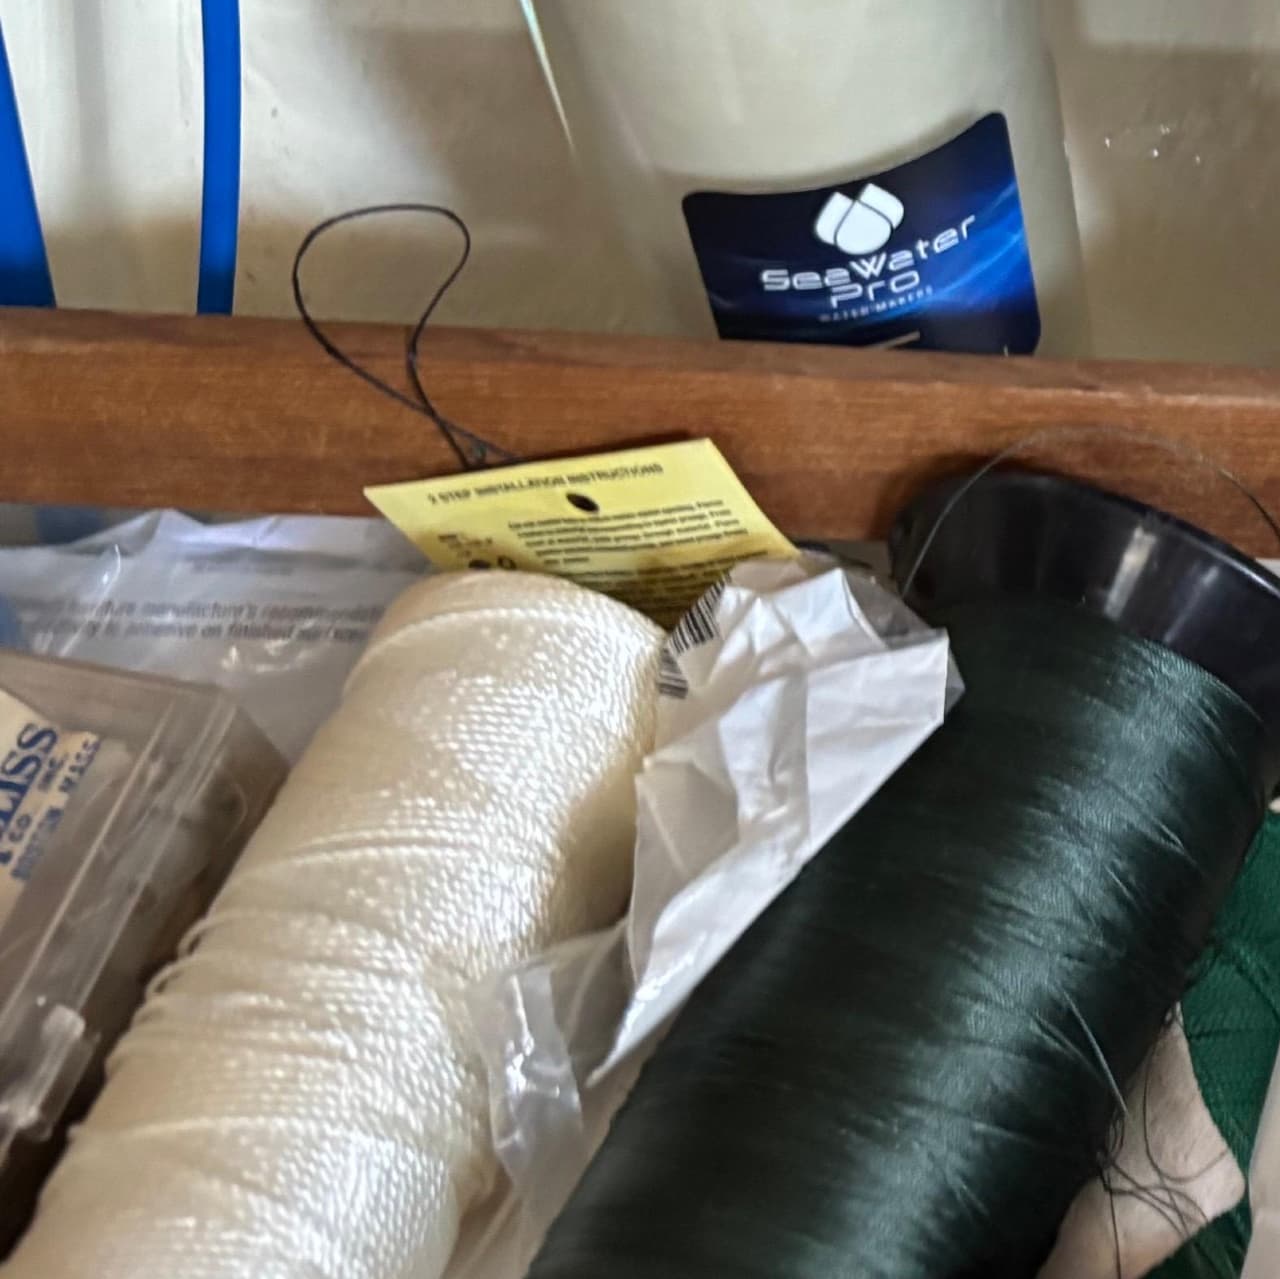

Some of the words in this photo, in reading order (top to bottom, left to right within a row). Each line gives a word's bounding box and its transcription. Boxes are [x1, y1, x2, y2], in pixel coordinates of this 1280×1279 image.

[761, 214, 975, 291] SeaWater
[830, 270, 920, 309] Pro
[476, 474, 566, 498] INSTALLATION
[567, 462, 664, 485] INSTRUCTIONS
